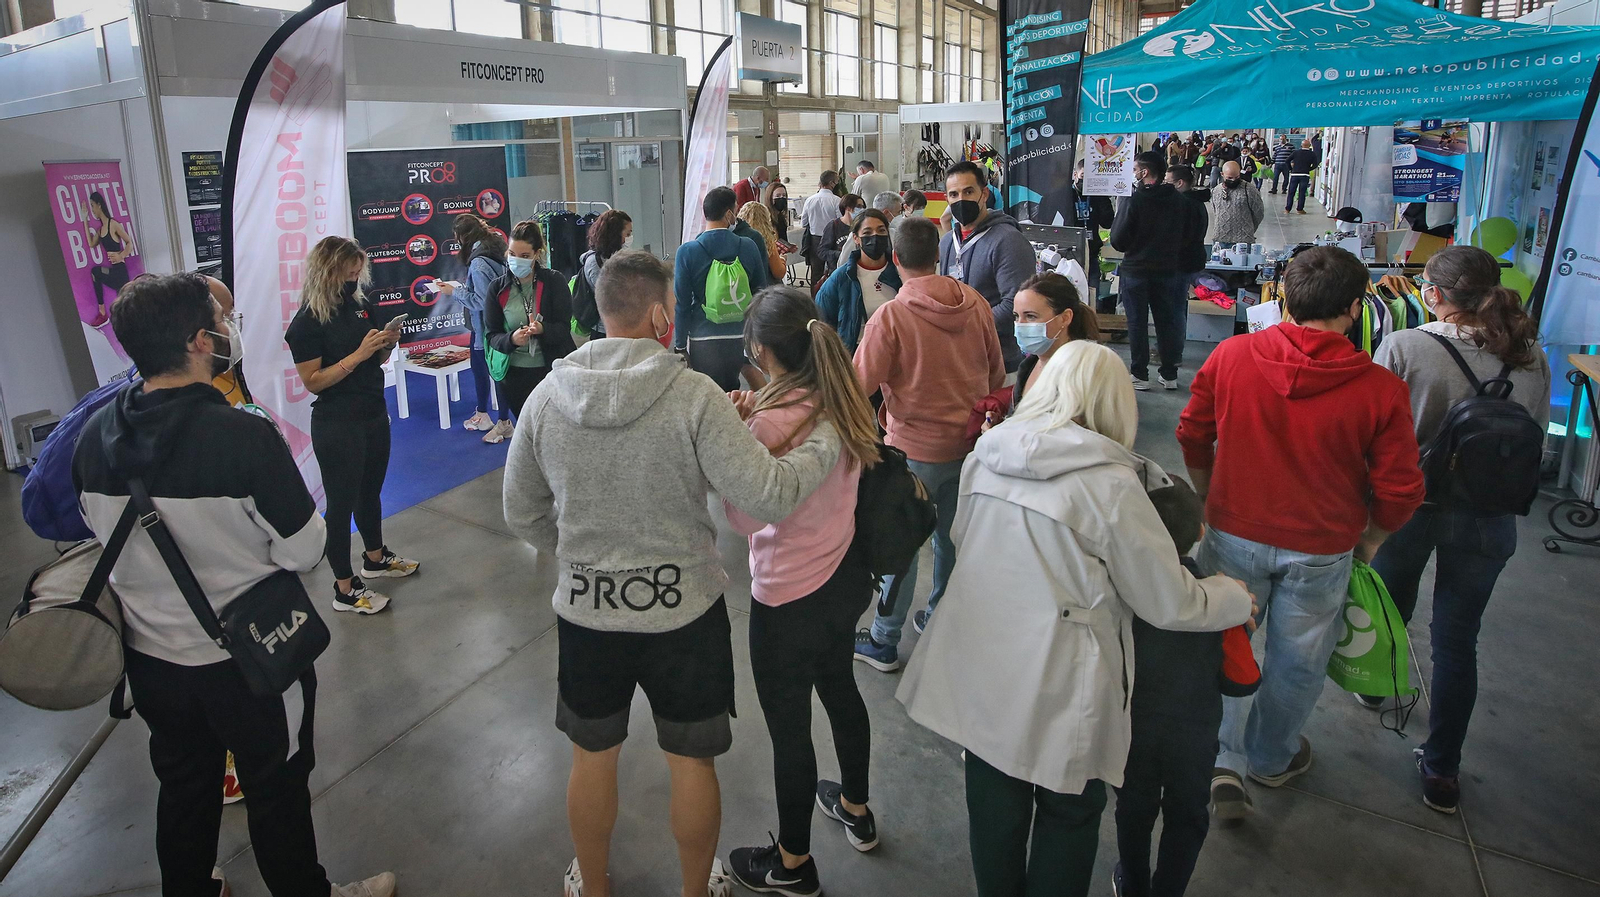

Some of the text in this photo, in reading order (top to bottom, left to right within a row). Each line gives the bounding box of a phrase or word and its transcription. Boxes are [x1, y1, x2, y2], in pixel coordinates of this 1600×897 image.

[1032, 21, 1088, 40] DEPORTIVOS
[1189, 19, 1372, 60] PUBLICIDAD
[751, 39, 795, 60] PUERTA 2
[460, 61, 545, 84] FITCONCEPT PRO
[1014, 53, 1075, 74] ONALIZACIÓN
[1339, 77, 1592, 96] MERCHANDISING EVENTOS DEPORTIVOS DIS
[1011, 89, 1054, 109] TULACIÓN
[1305, 89, 1587, 109] PERSONALIZACIÓN TEXTIL IMPRENTA ROTULACI
[1011, 110, 1045, 128] MPRENTA
[1080, 111, 1144, 123] LICIDAD
[407, 161, 444, 169] FITCONCEPT
[361, 206, 400, 216] BODYJUMP
[443, 200, 474, 210] BOXING
[66, 221, 139, 270] BOM
[366, 249, 406, 258] GLUTEBOOM
[379, 292, 402, 301] PYRO
[402, 324, 434, 335] TNESS
[261, 609, 308, 655] FILA
